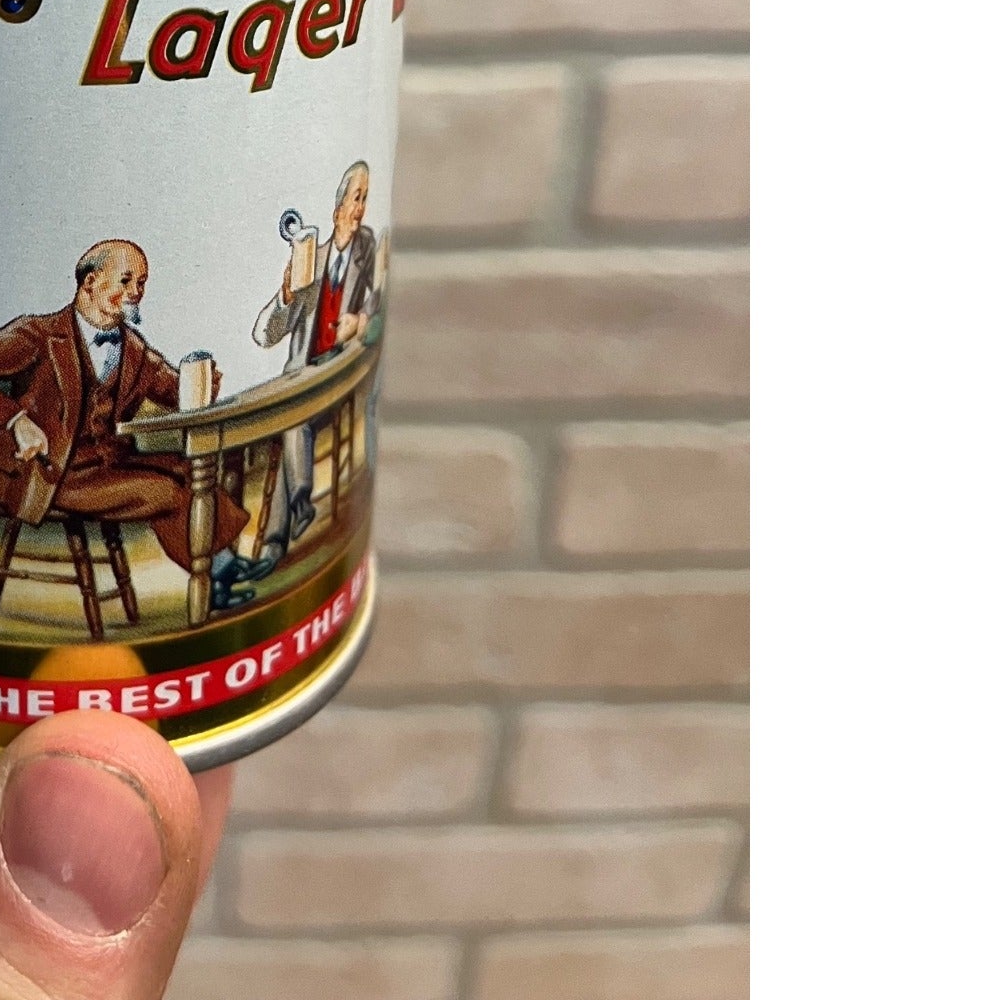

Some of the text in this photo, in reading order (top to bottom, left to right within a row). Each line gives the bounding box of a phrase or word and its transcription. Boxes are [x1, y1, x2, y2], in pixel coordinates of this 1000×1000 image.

[78, 671, 210, 713] BEST
[224, 641, 283, 690] OF
[292, 591, 346, 656] THE
